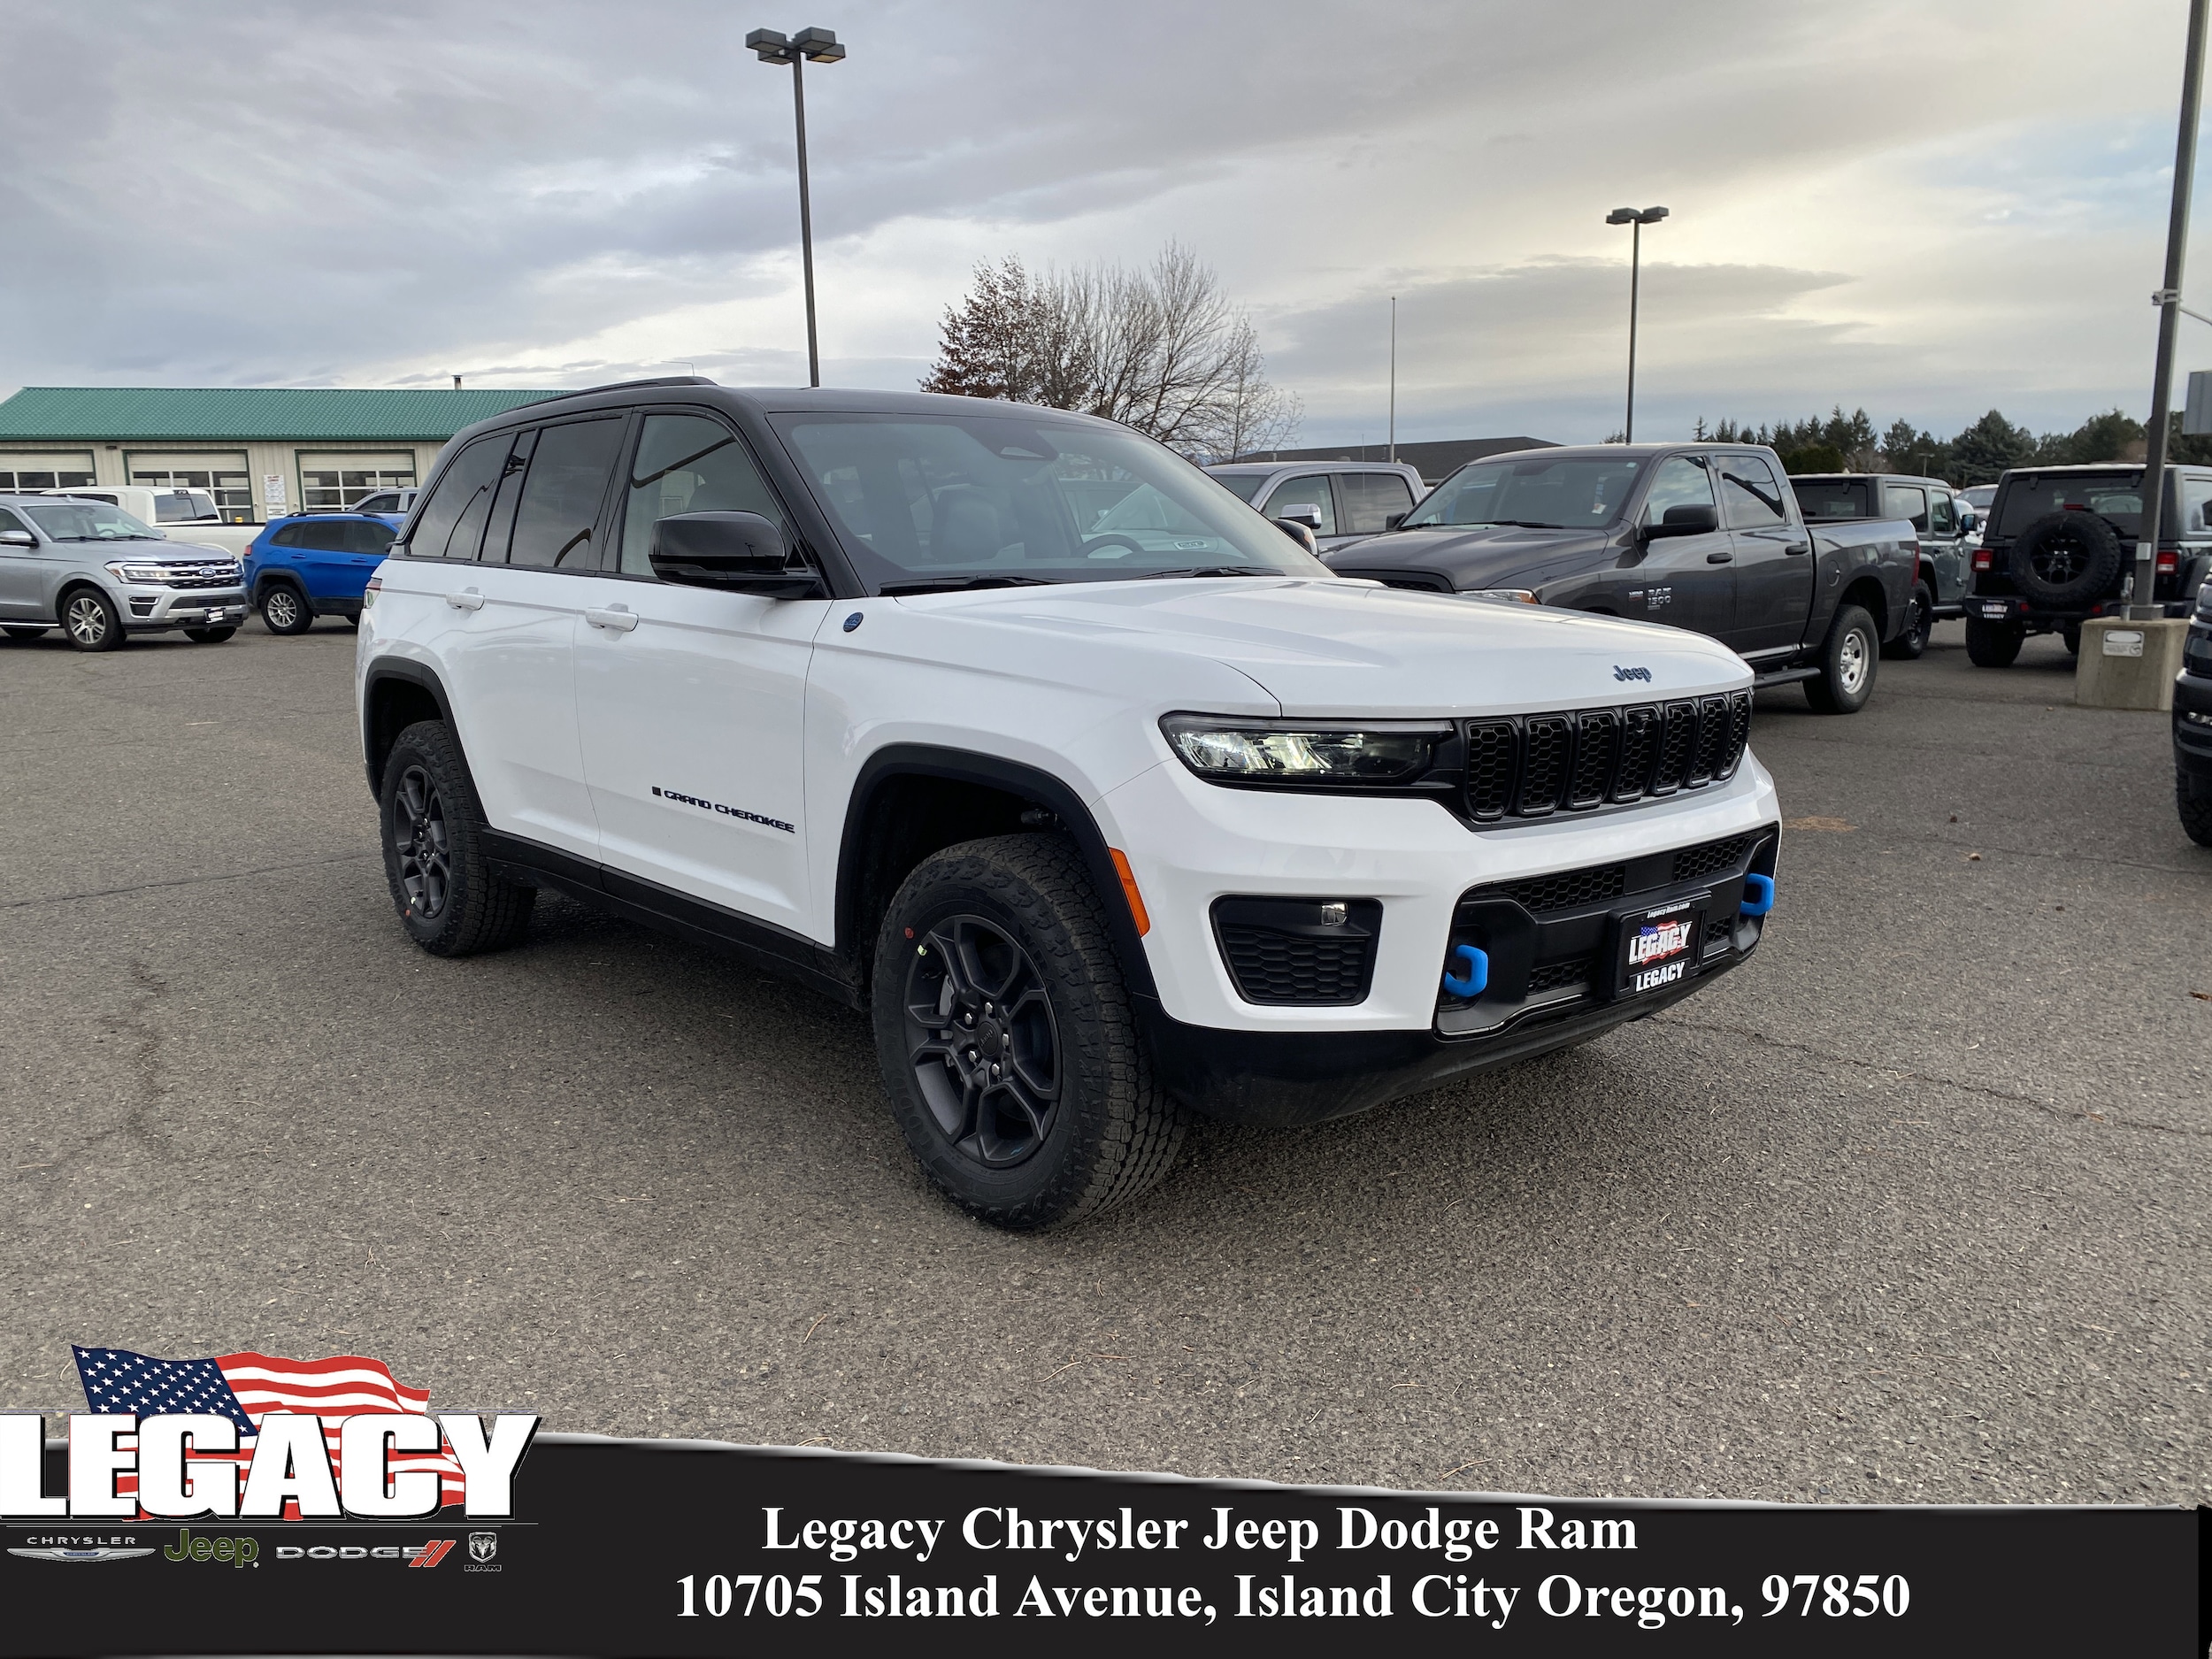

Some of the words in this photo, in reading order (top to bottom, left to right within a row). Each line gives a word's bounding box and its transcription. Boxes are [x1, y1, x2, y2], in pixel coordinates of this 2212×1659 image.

[1647, 595, 1671, 605] 1500
[1613, 665, 1652, 683] Jeep
[664, 790, 711, 810] GRAND
[715, 803, 795, 833] CHEROKEE
[1629, 923, 1692, 963] LEGACY
[1636, 962, 1685, 992] LEGACY
